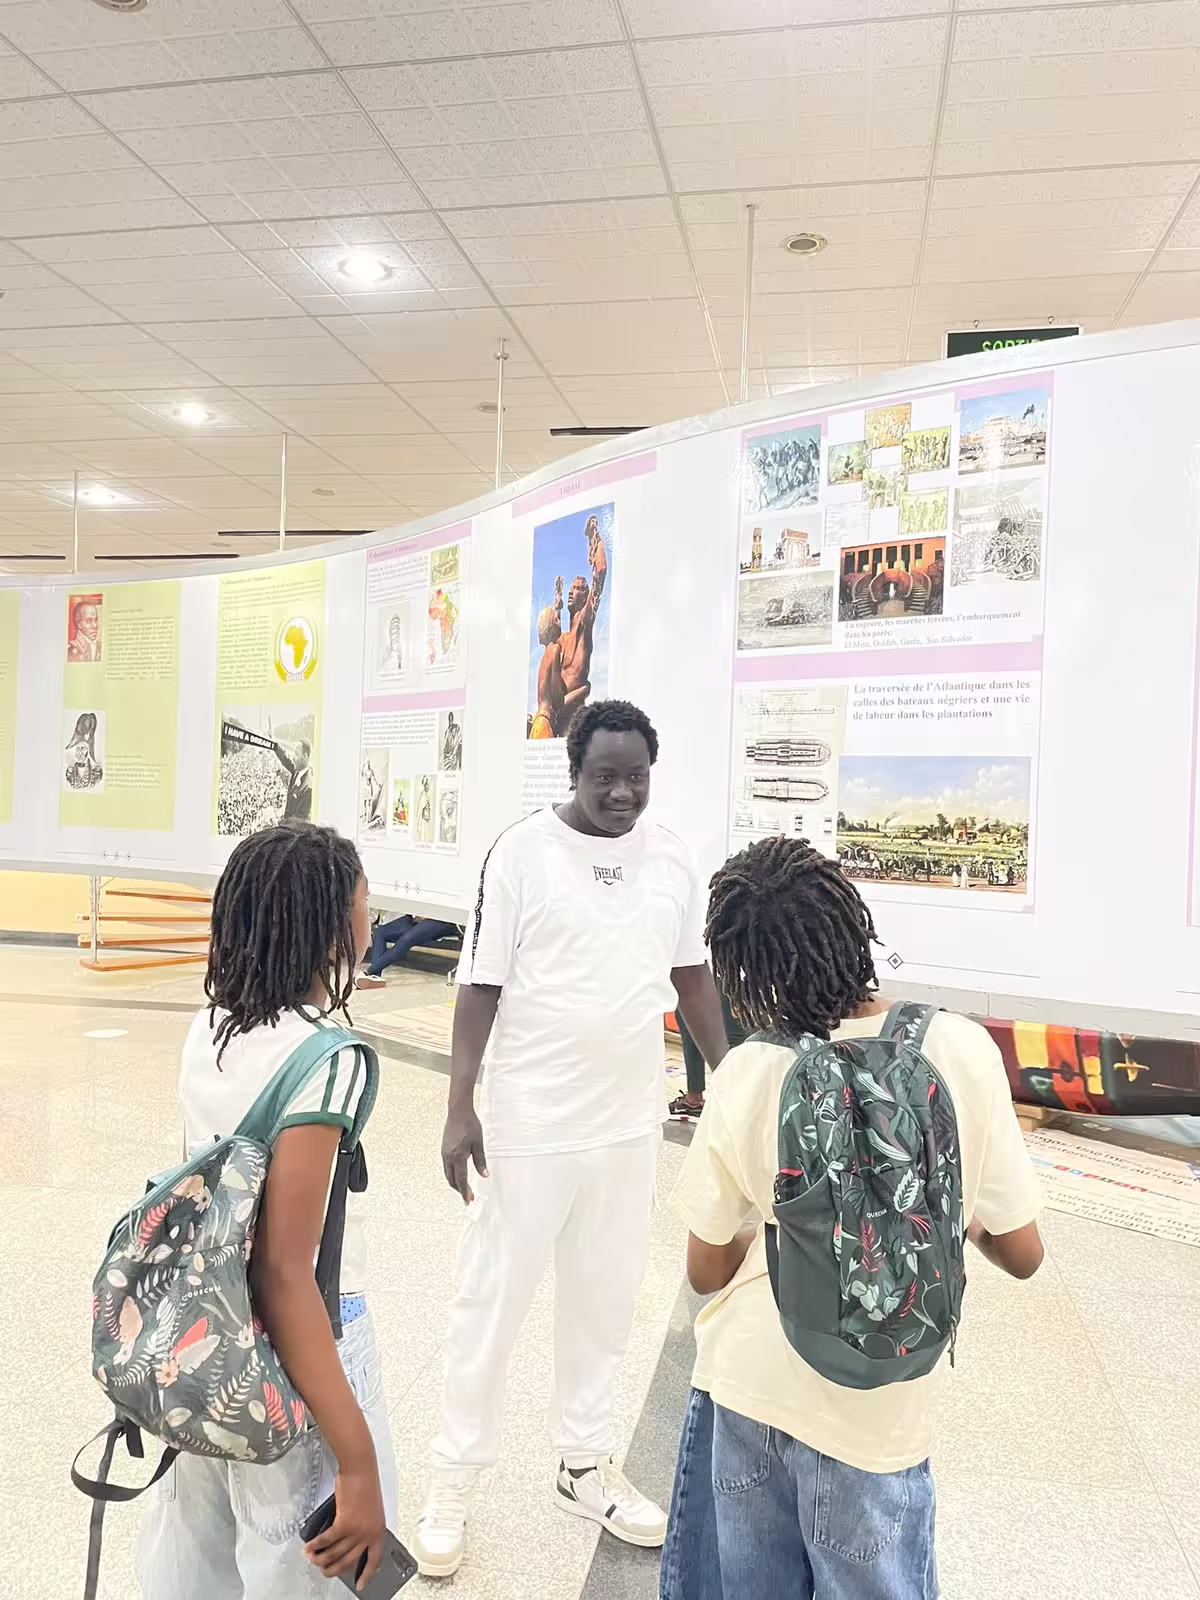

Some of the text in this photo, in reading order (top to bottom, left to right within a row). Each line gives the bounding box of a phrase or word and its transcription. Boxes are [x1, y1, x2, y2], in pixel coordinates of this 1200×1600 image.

[895, 617, 926, 626] marches
[854, 679, 1031, 694] La traversée de l'Atlantique dans les
[879, 697, 895, 707] des
[897, 695, 935, 706] bateaux
[937, 694, 978, 707] négriers
[980, 695, 990, 704] et
[993, 696, 1012, 704] une
[1015, 693, 1030, 704] vie
[852, 708, 993, 721] de labeur dans les plantations
[228, 726, 245, 740] HAVE
[244, 732, 250, 742] A
[250, 735, 272, 749] DREAM
